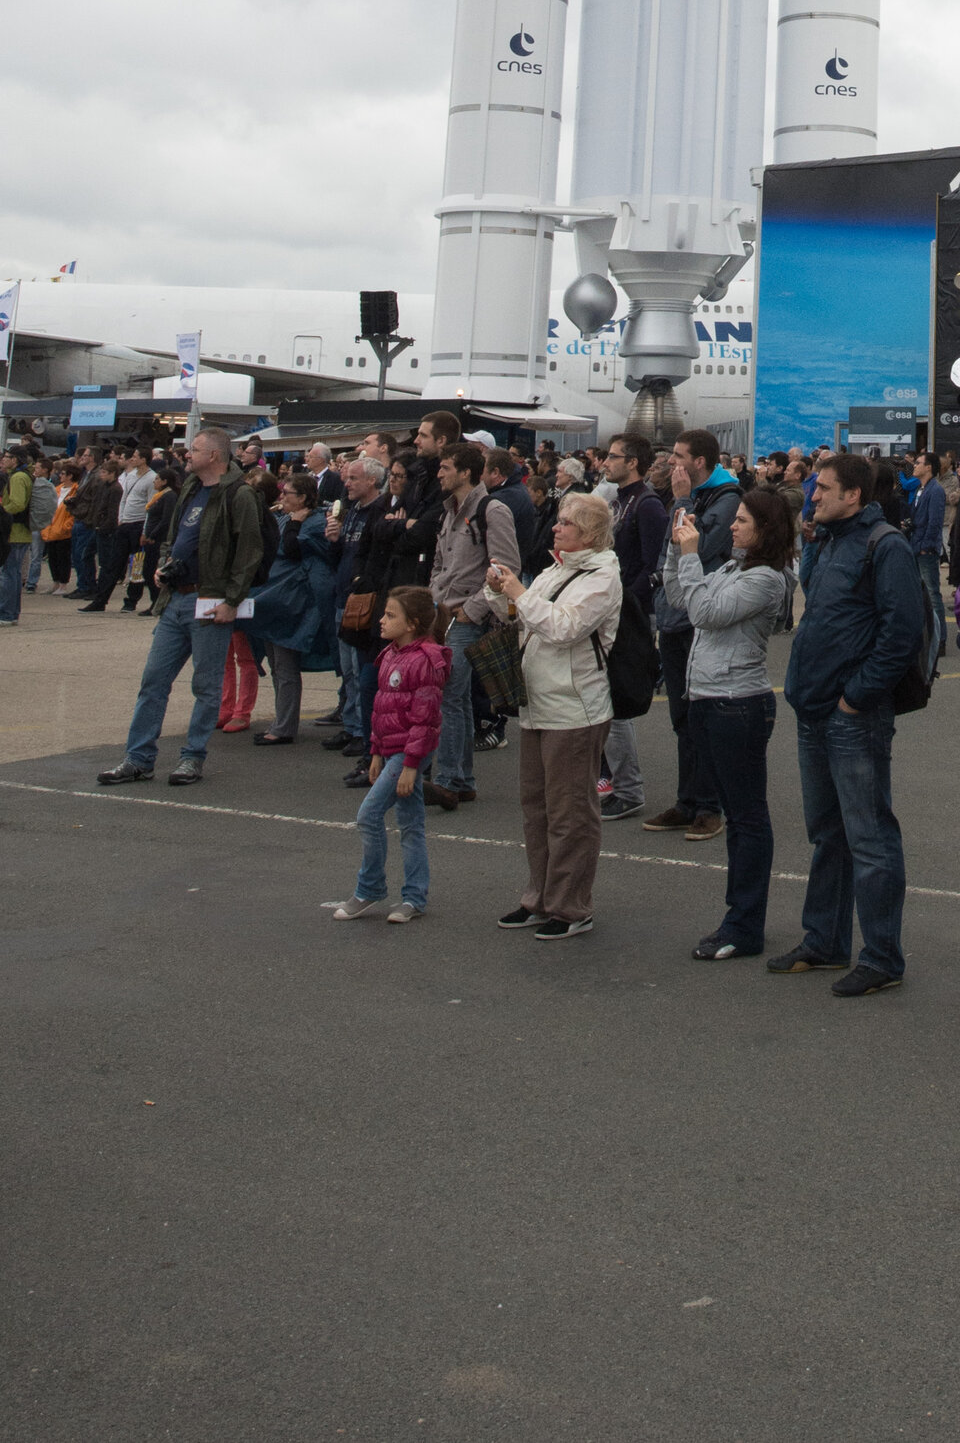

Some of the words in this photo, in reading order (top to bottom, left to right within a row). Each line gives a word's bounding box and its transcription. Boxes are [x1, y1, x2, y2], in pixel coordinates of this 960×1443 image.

[497, 60, 542, 75] cnes
[814, 83, 857, 97] cnes
[566, 340, 592, 355] de
[896, 388, 918, 398] esa
[895, 411, 912, 419] esa
